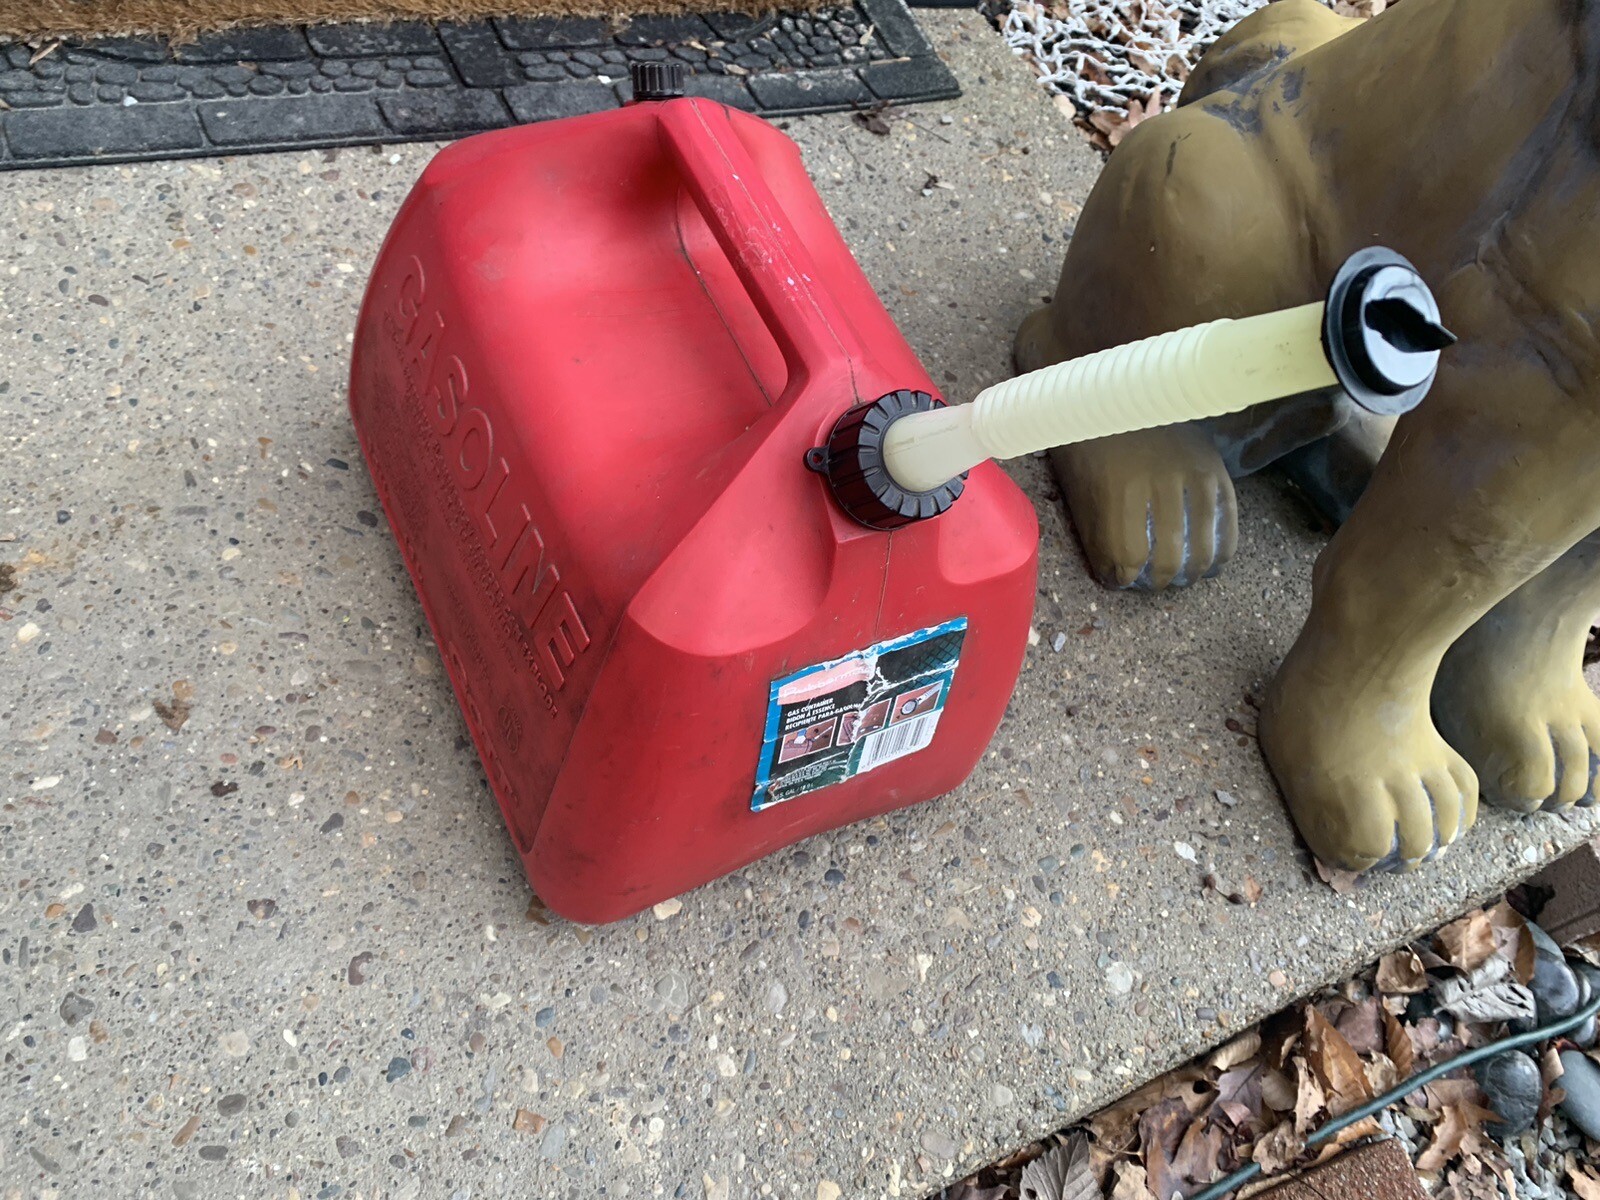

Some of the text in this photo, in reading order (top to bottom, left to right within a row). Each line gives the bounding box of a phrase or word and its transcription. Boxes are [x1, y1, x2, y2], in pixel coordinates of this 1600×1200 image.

[396, 253, 592, 691] GASOLINE
[520, 638, 557, 718] EXPLODE
[784, 665, 868, 696] Rubberm
[786, 712, 805, 723] BIDON
[812, 703, 835, 715] ESSENCE
[788, 697, 833, 717] GAS CONTAINER
[785, 715, 815, 730] RECIPIENTE
